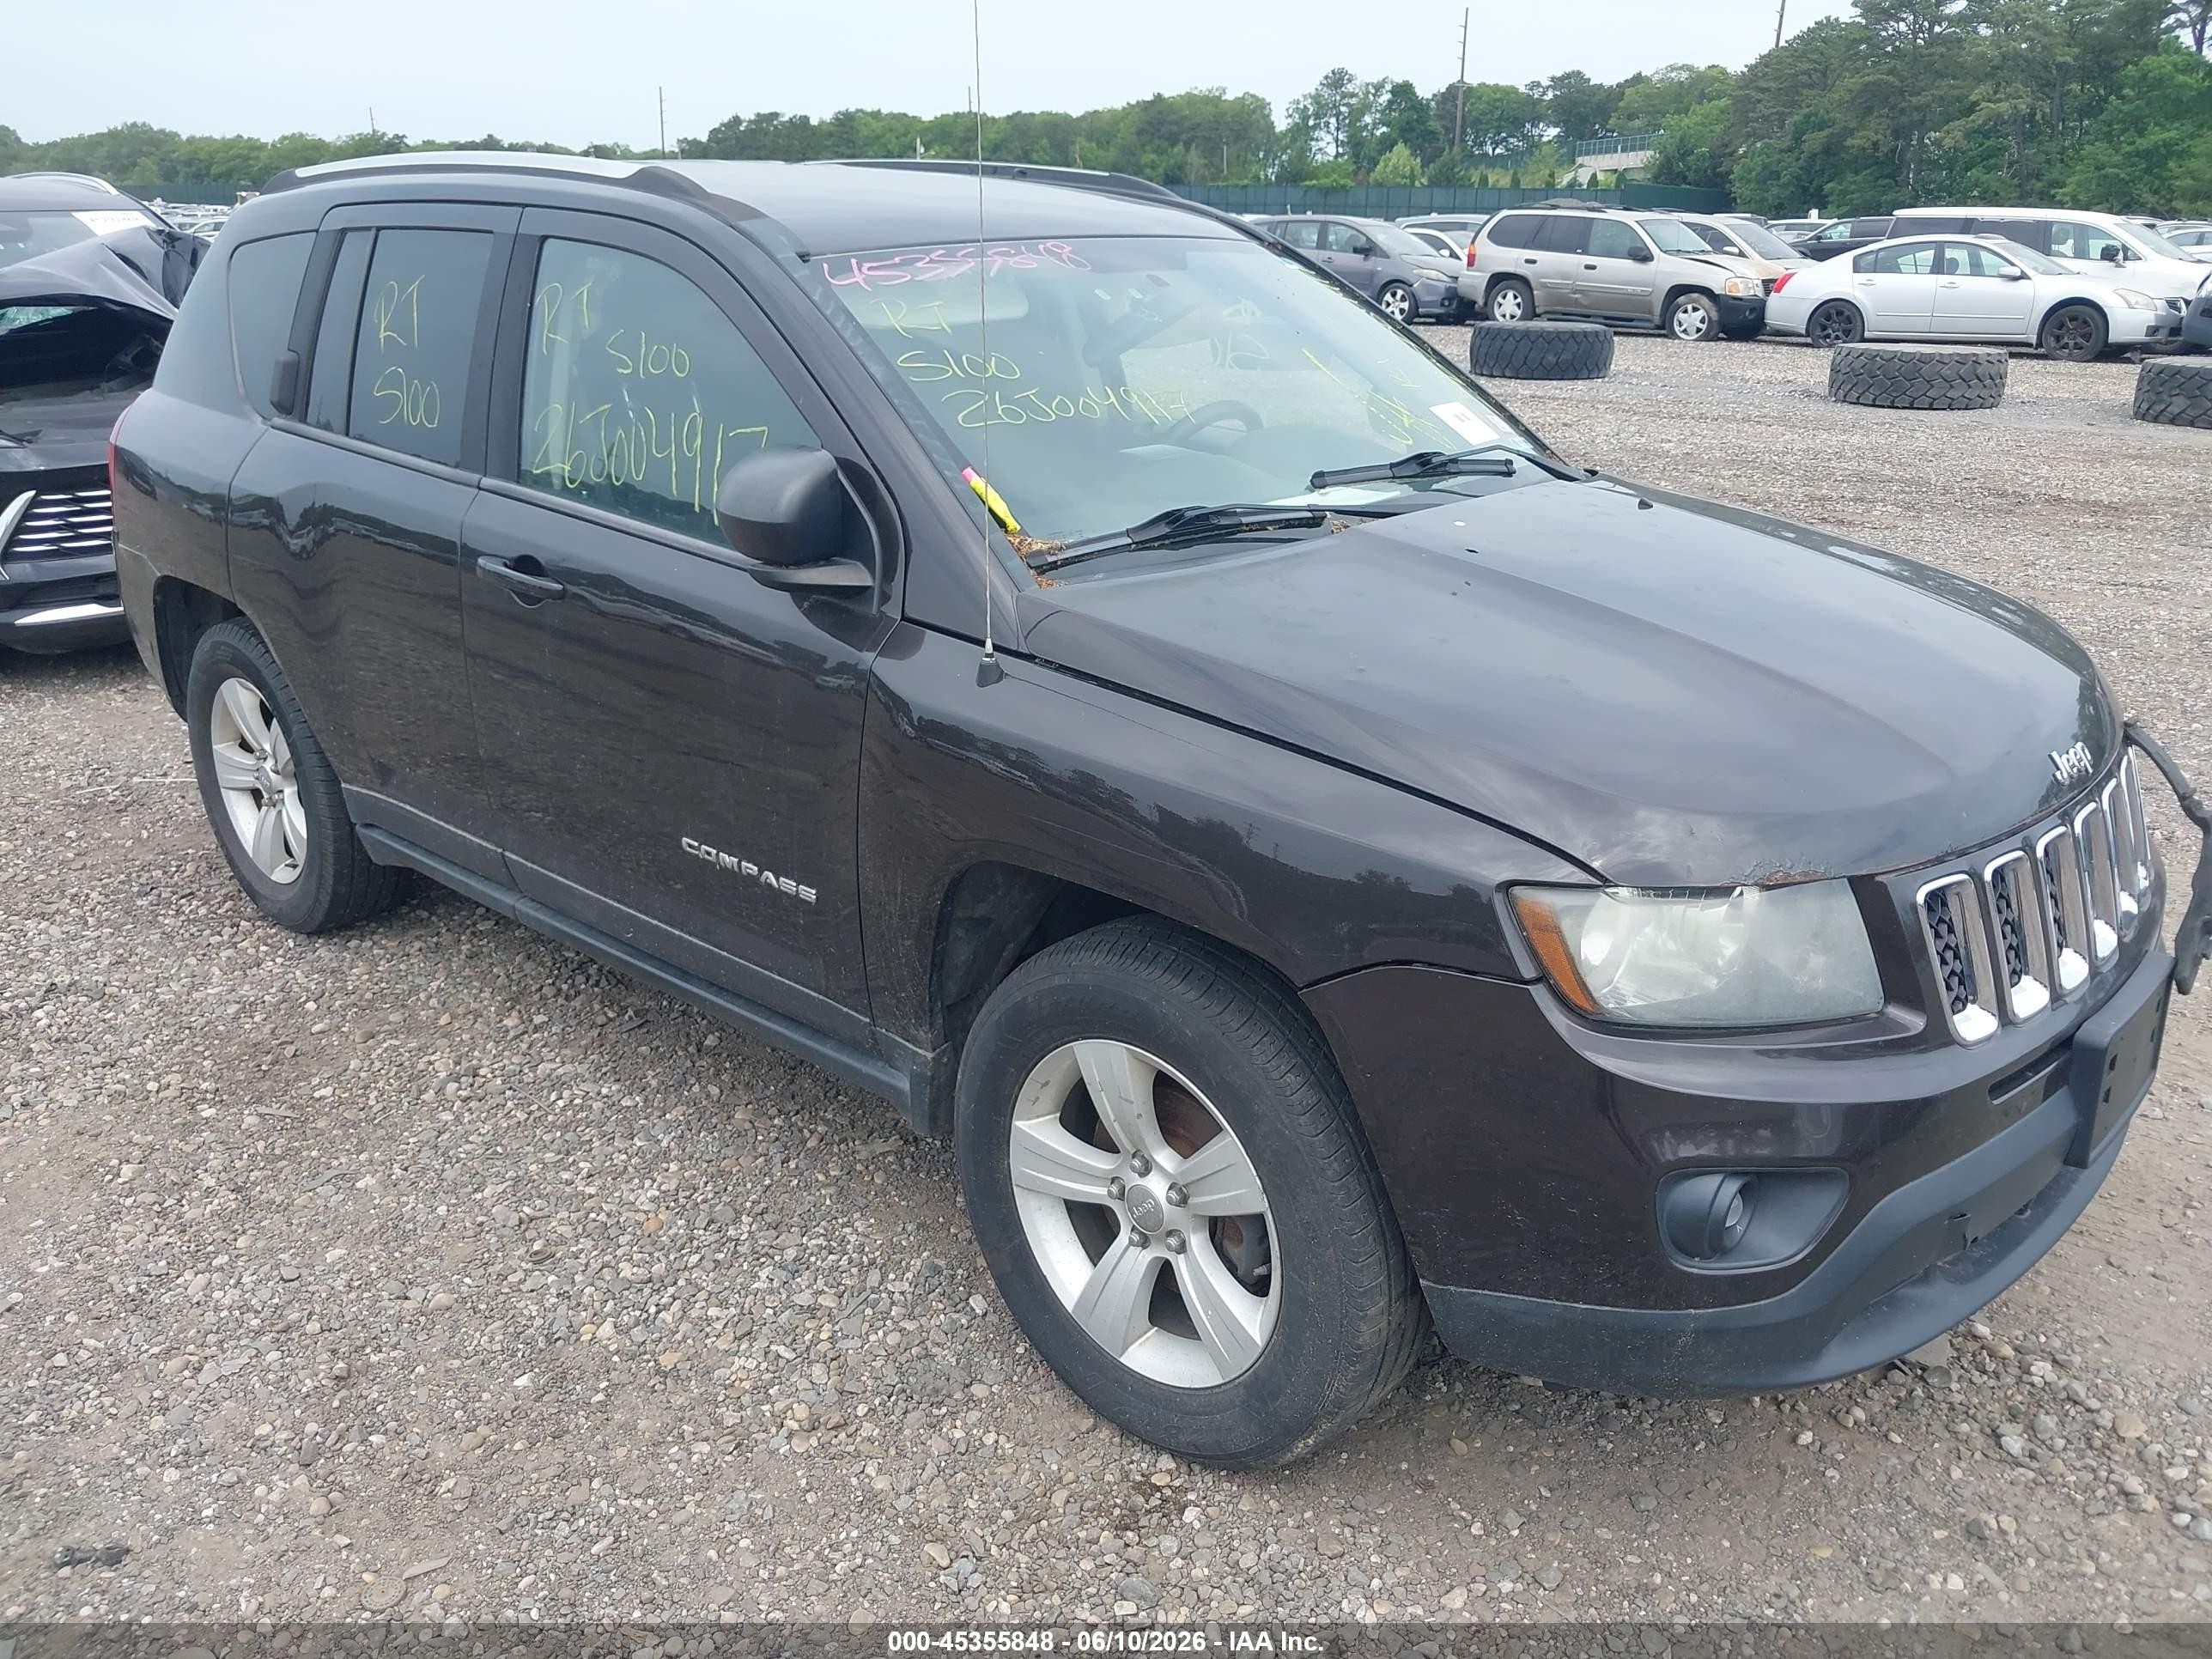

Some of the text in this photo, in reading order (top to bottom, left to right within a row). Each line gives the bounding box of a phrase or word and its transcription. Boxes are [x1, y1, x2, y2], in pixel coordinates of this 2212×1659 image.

[374, 275, 425, 353] RT
[536, 282, 592, 356] RT
[868, 297, 954, 339] RT
[605, 329, 690, 379] S100
[896, 349, 1021, 381] S100
[373, 367, 441, 428] S100
[2049, 740, 2094, 785] Jeep
[681, 836, 817, 906] COMPASS
[1132, 1198, 1156, 1218] Jeep
